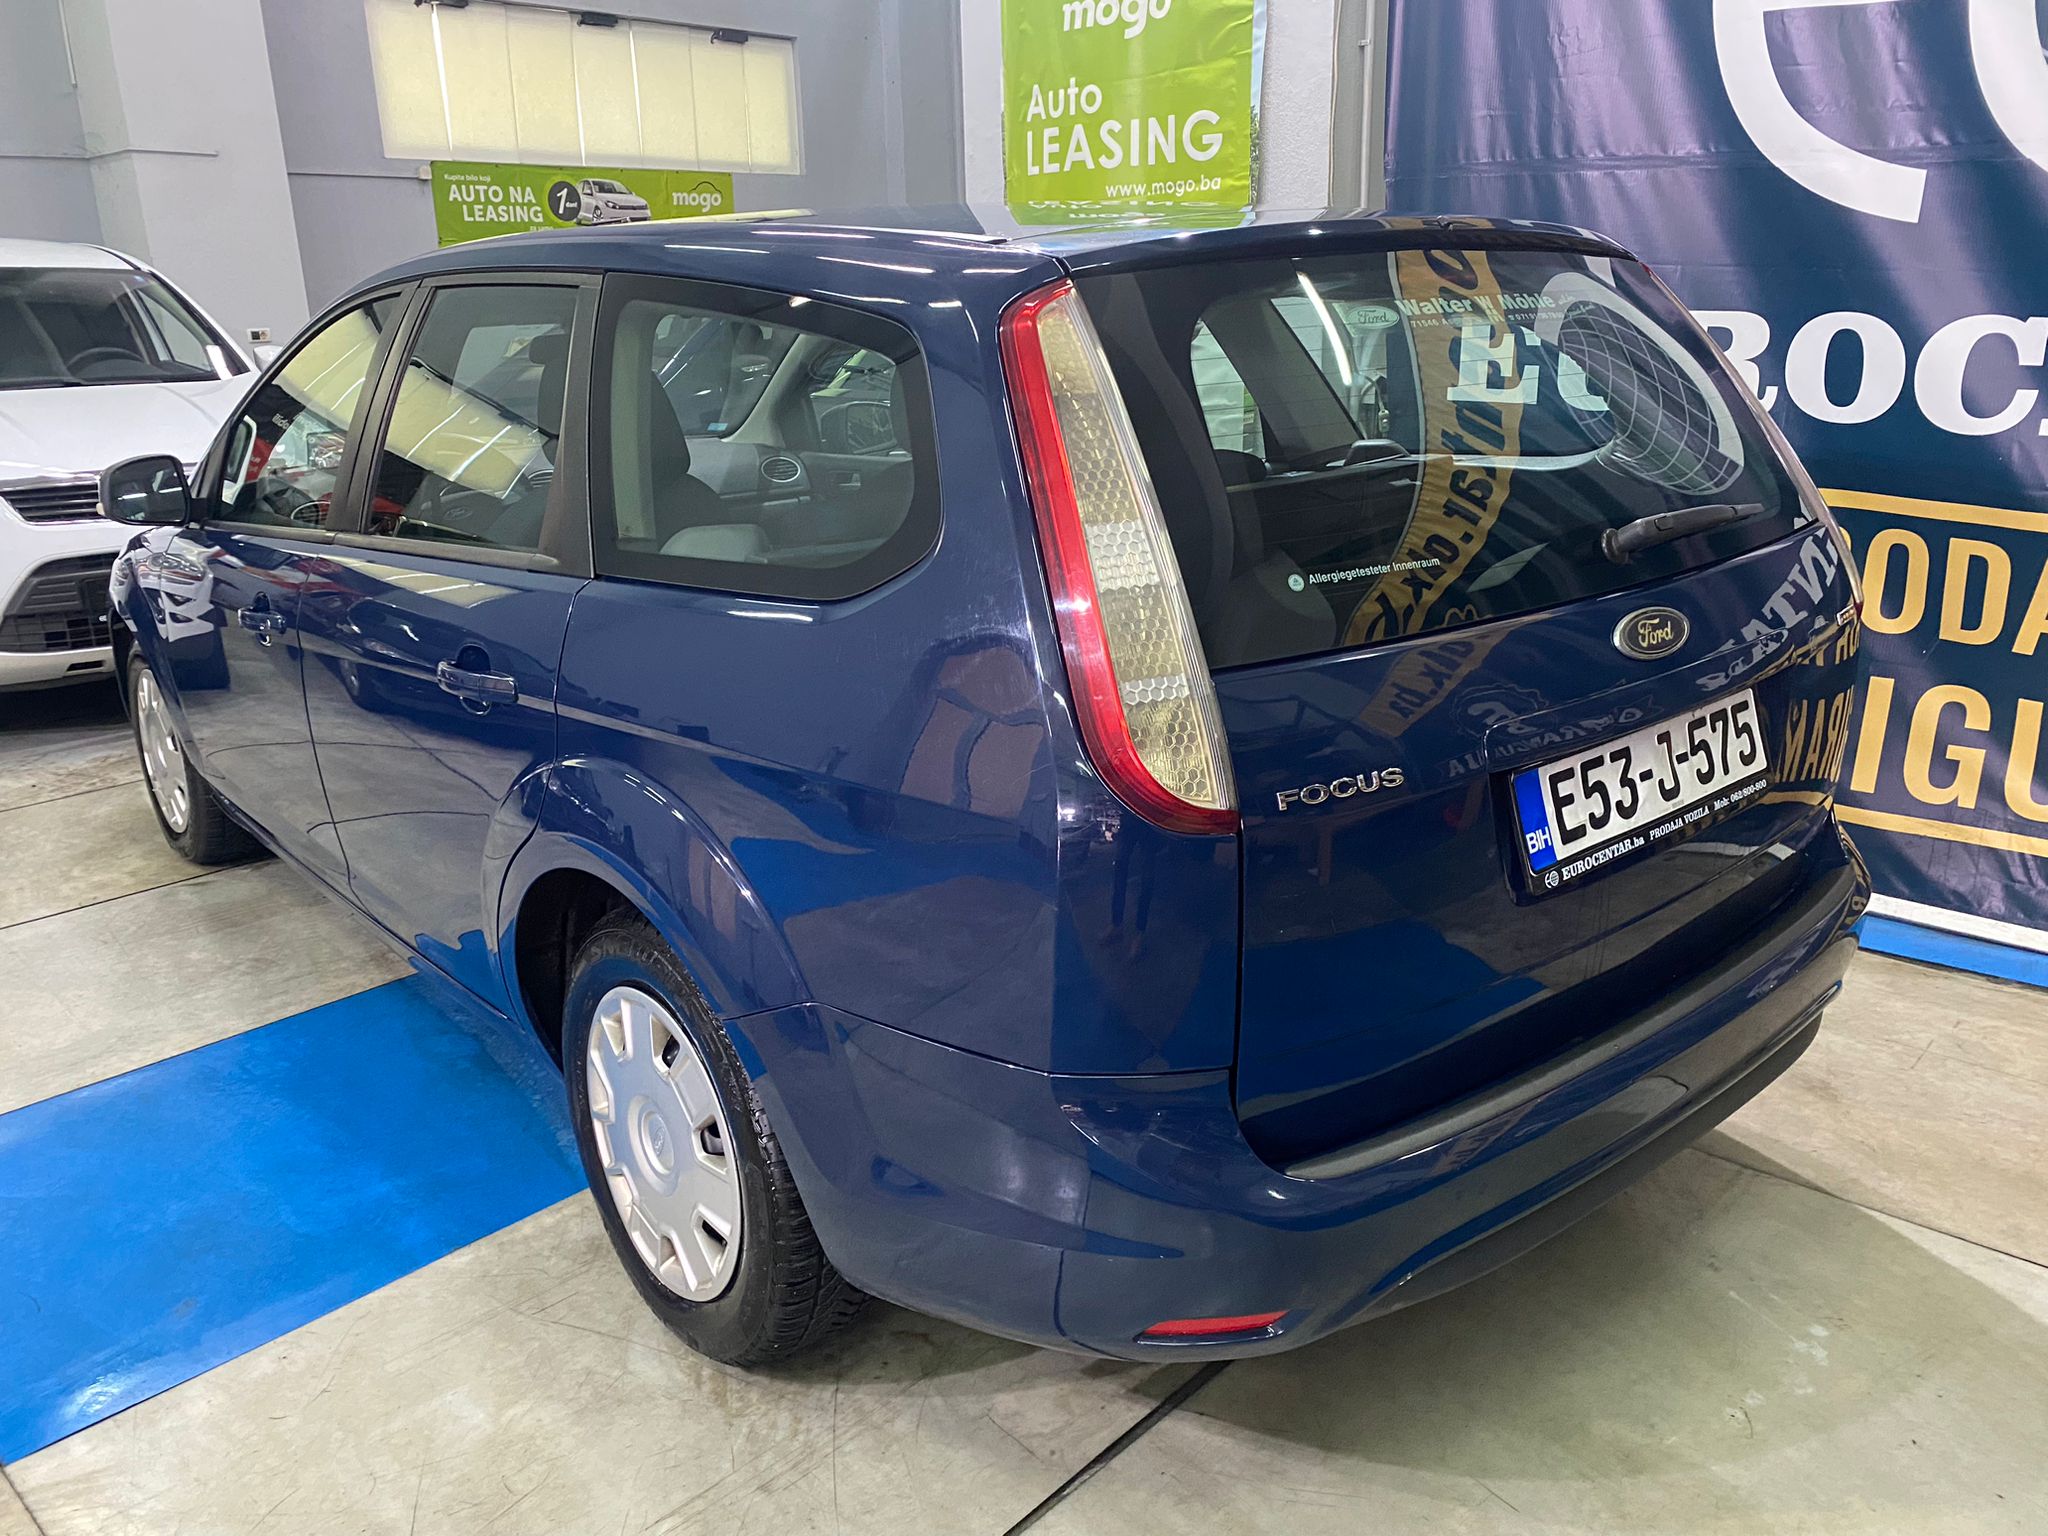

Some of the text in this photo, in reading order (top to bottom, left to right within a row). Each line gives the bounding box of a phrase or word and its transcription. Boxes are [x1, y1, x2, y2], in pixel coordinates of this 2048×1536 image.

[1026, 77, 1103, 123] Auto
[1026, 109, 1223, 176] LEASING
[448, 184, 536, 203] AUTO NA
[1105, 174, 1222, 198] www.mogo.ba
[462, 204, 544, 223] LEASING
[556, 187, 568, 214] 1
[672, 190, 722, 213] mogo
[1356, 308, 1390, 325] Ford
[1395, 296, 1473, 317] Walter
[1497, 293, 1556, 312] Möhle
[1309, 557, 1441, 584] Allergiegetesteter Innenraum
[1637, 618, 1675, 646] Ford
[1548, 699, 1757, 846] E53-J-575
[1276, 767, 1405, 811] FOCUS
[1525, 826, 1553, 855] BIH
[1562, 836, 1645, 880] EUROCENTAR.ba
[1649, 818, 1684, 840] PRODAJA
[1683, 805, 1710, 824] VOZILA
